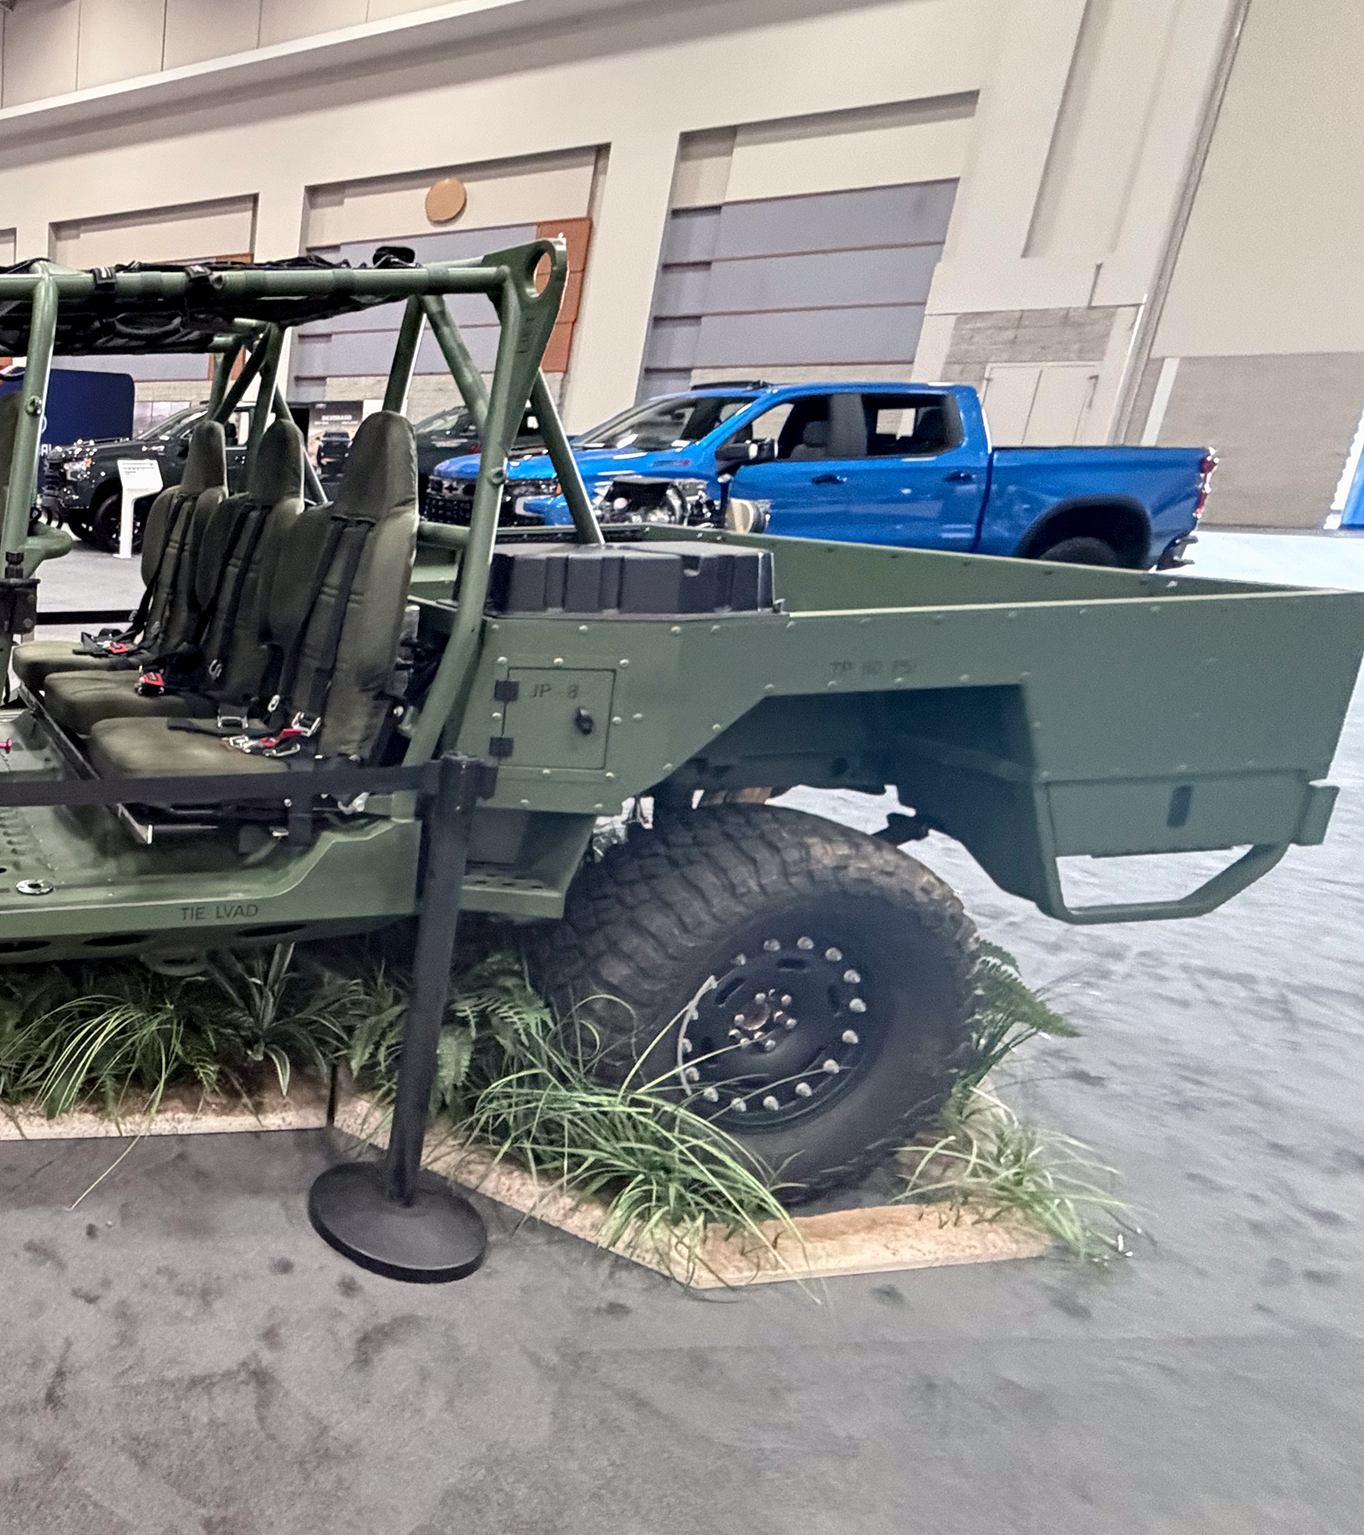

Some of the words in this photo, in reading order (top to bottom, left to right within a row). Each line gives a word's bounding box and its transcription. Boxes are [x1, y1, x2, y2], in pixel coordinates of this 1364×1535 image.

[529, 683, 552, 698] JP
[181, 906, 205, 920] TIE
[215, 904, 259, 919] LVAD
